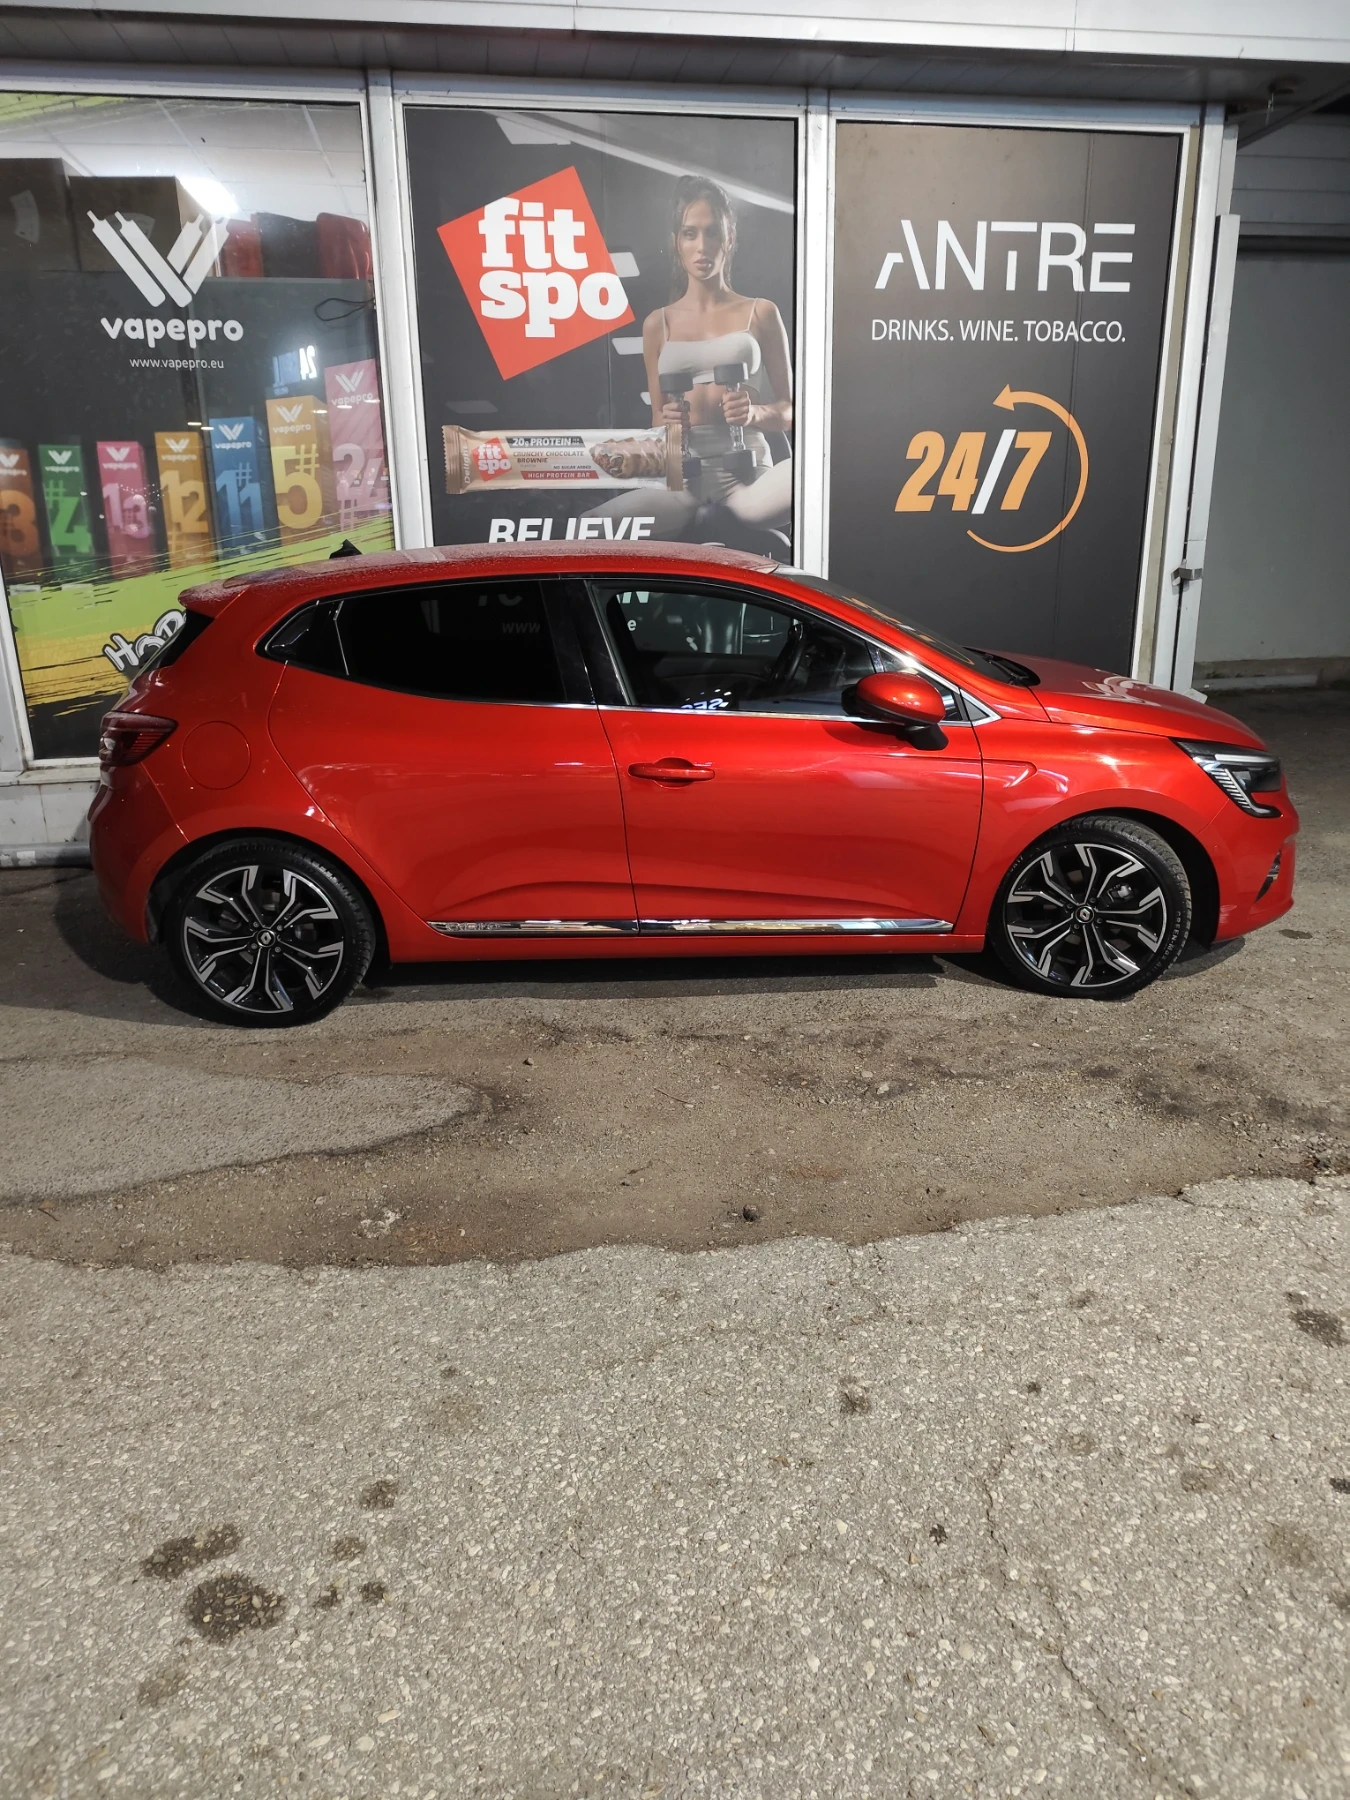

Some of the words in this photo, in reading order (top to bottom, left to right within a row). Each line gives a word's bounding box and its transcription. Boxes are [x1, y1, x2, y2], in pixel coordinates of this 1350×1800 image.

[478, 197, 589, 271] fit
[874, 219, 1136, 292] ANTRE
[478, 270, 629, 338] spo
[100, 317, 244, 348] vapepro
[871, 319, 955, 342] DRINKS.
[959, 320, 1019, 342] WINE.
[1023, 320, 1127, 343] TOBACCO.
[129, 357, 225, 371] www.vapepro.eu
[331, 392, 374, 406] vapepro
[272, 422, 312, 434] vapepro
[214, 440, 252, 450] vapepro
[530, 437, 571, 447] PROTEIN
[161, 453, 198, 462] vapepro
[477, 444, 502, 459] fit
[478, 459, 511, 474] spo
[894, 429, 1053, 515] 24/7
